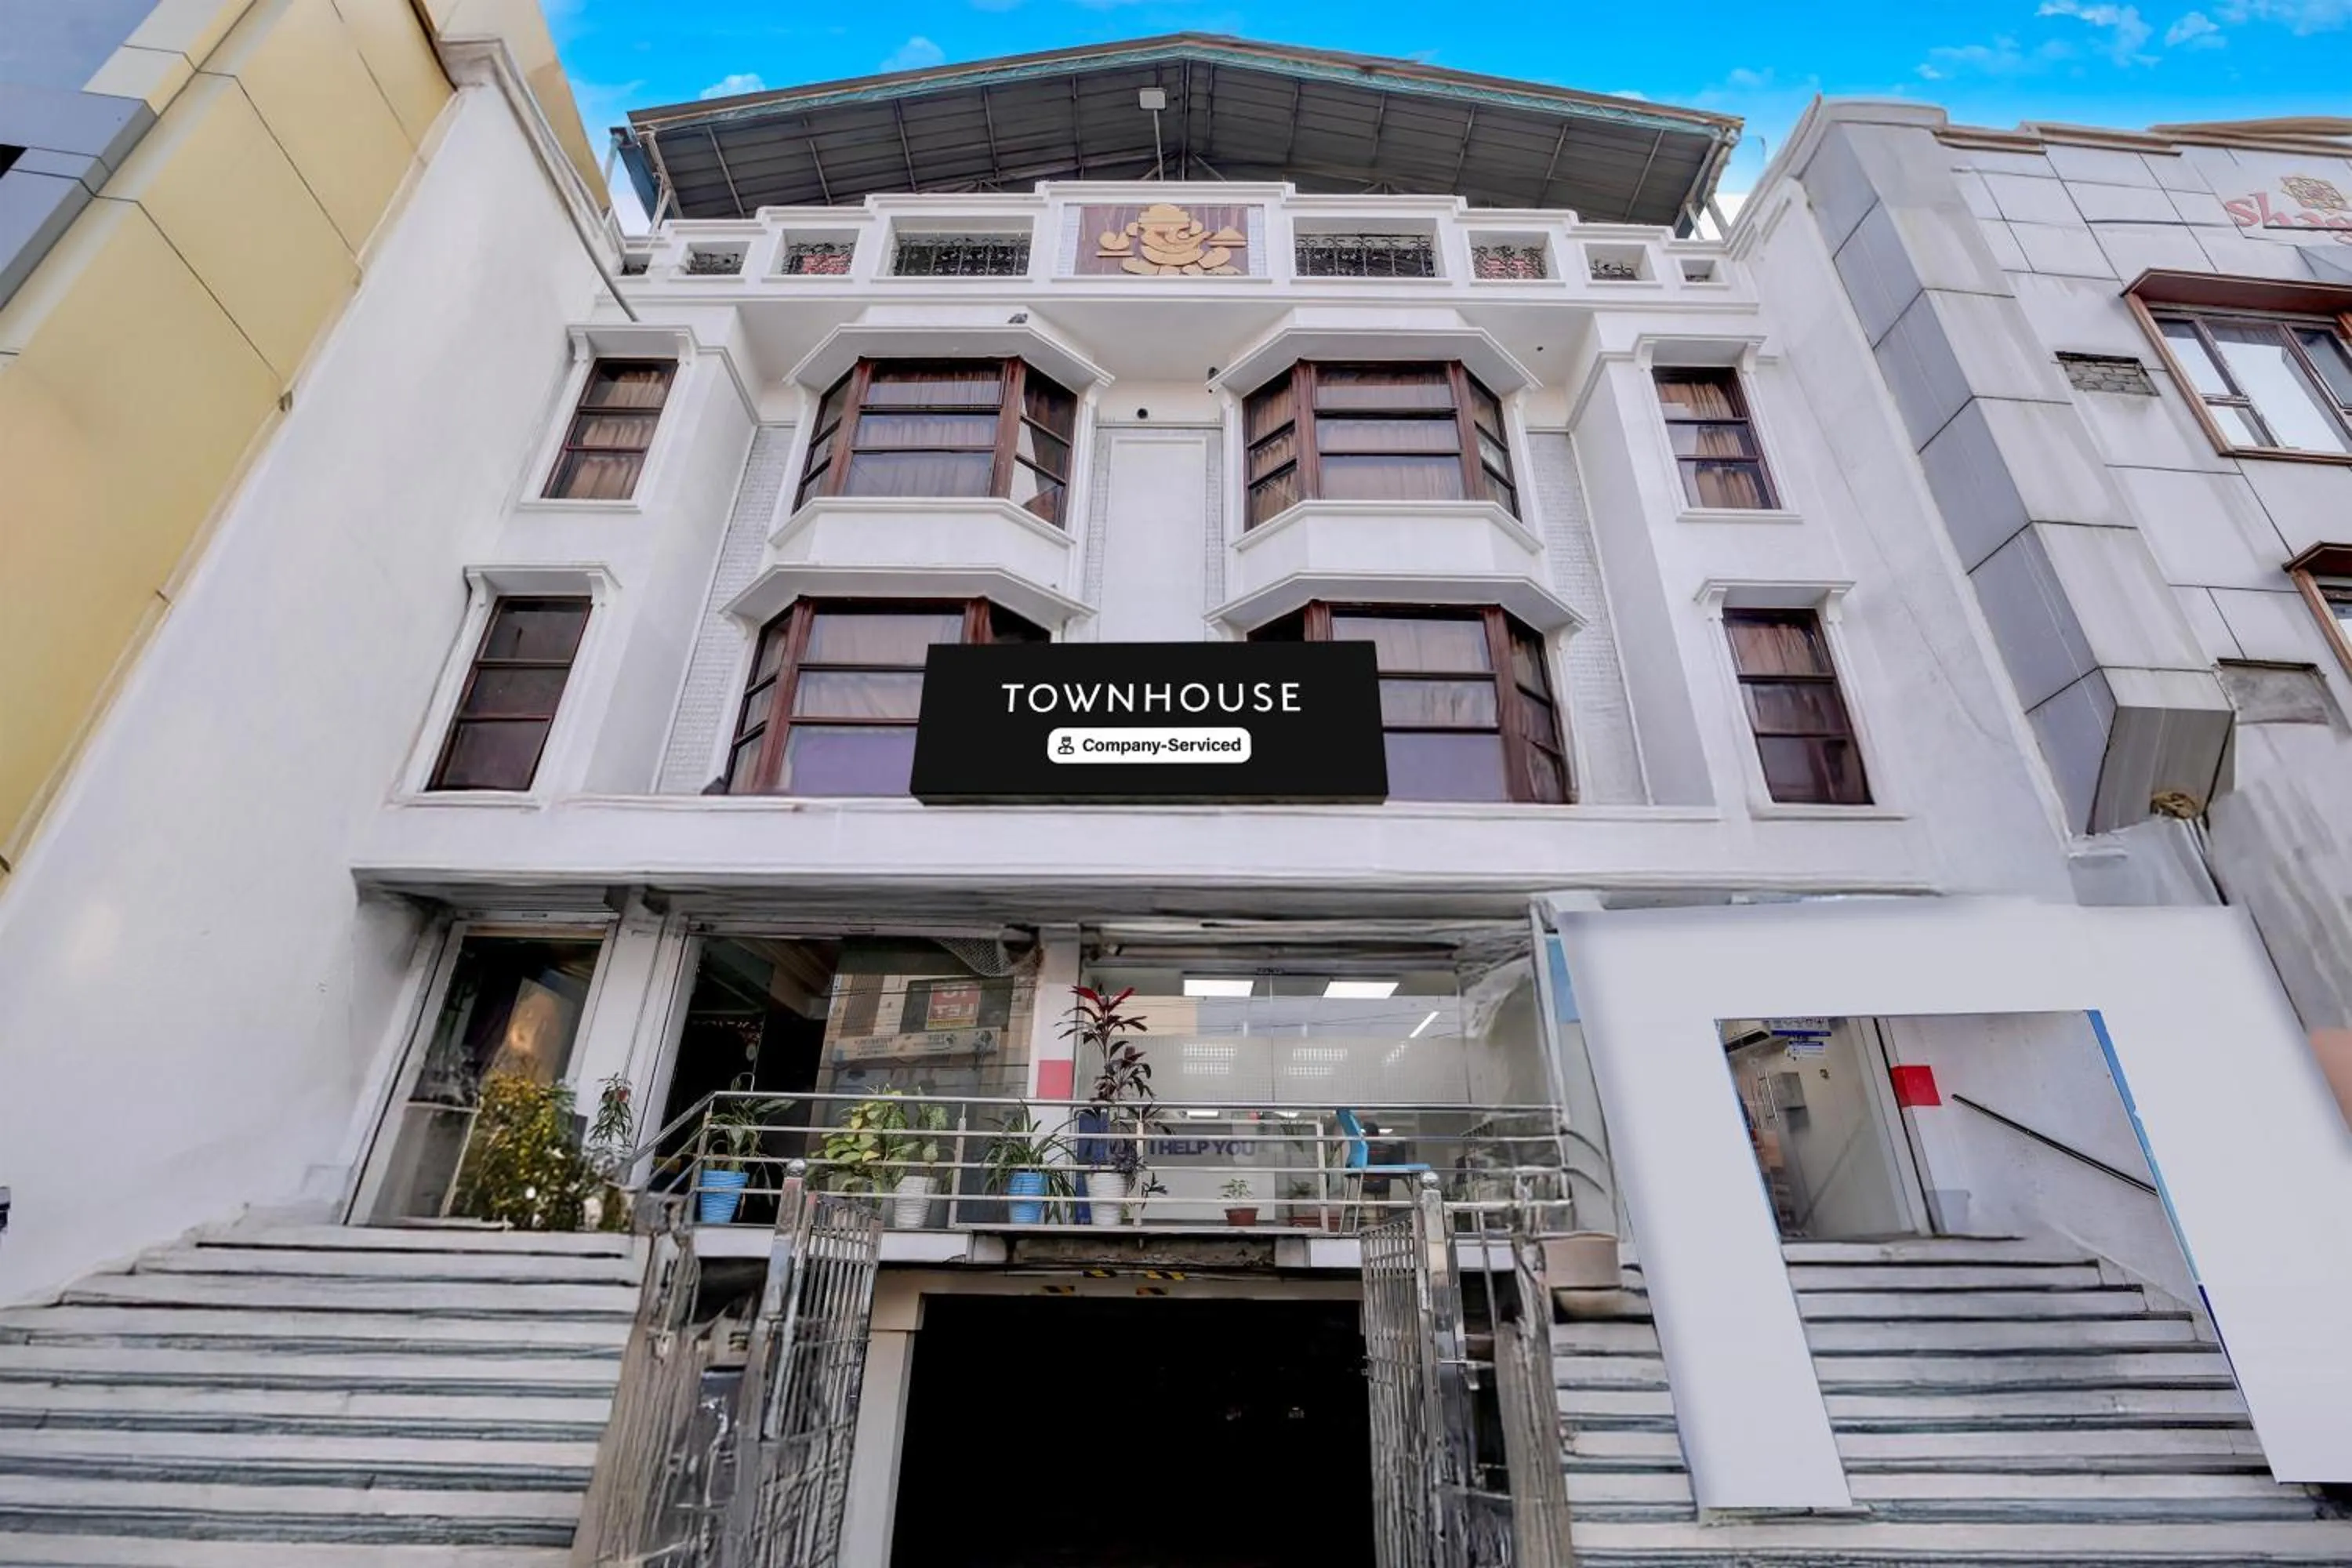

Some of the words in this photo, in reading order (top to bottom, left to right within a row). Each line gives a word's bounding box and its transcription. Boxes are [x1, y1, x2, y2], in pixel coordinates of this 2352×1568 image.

[1001, 682, 1301, 713] TOWNHOUSE
[1082, 737, 1243, 756] Company-Serviced
[1158, 1138, 1209, 1155] HELP
[1214, 1138, 1256, 1156] YOU
